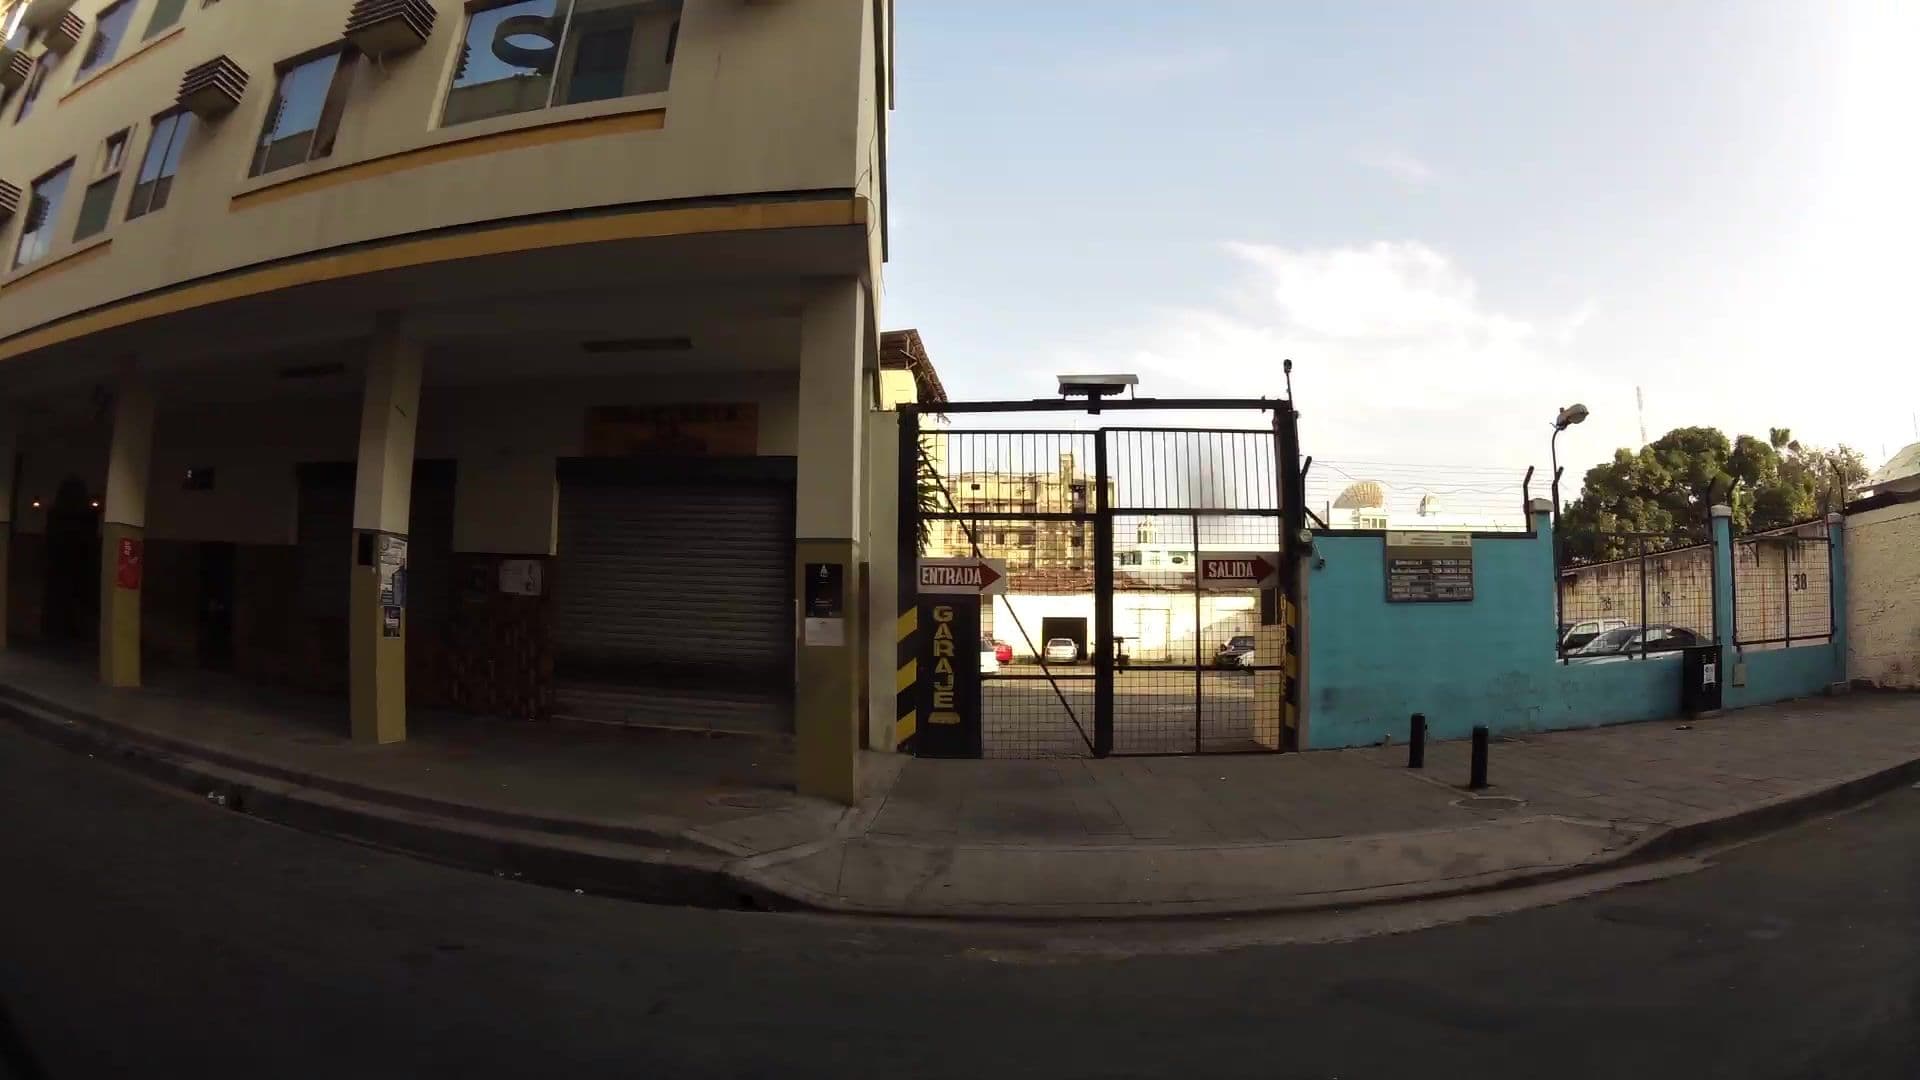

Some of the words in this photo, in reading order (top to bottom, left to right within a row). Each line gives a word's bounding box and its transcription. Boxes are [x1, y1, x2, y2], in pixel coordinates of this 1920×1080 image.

[922, 567, 982, 585] ENTRADA
[1208, 561, 1254, 578] SALIDA
[933, 605, 954, 708] GARAJE
